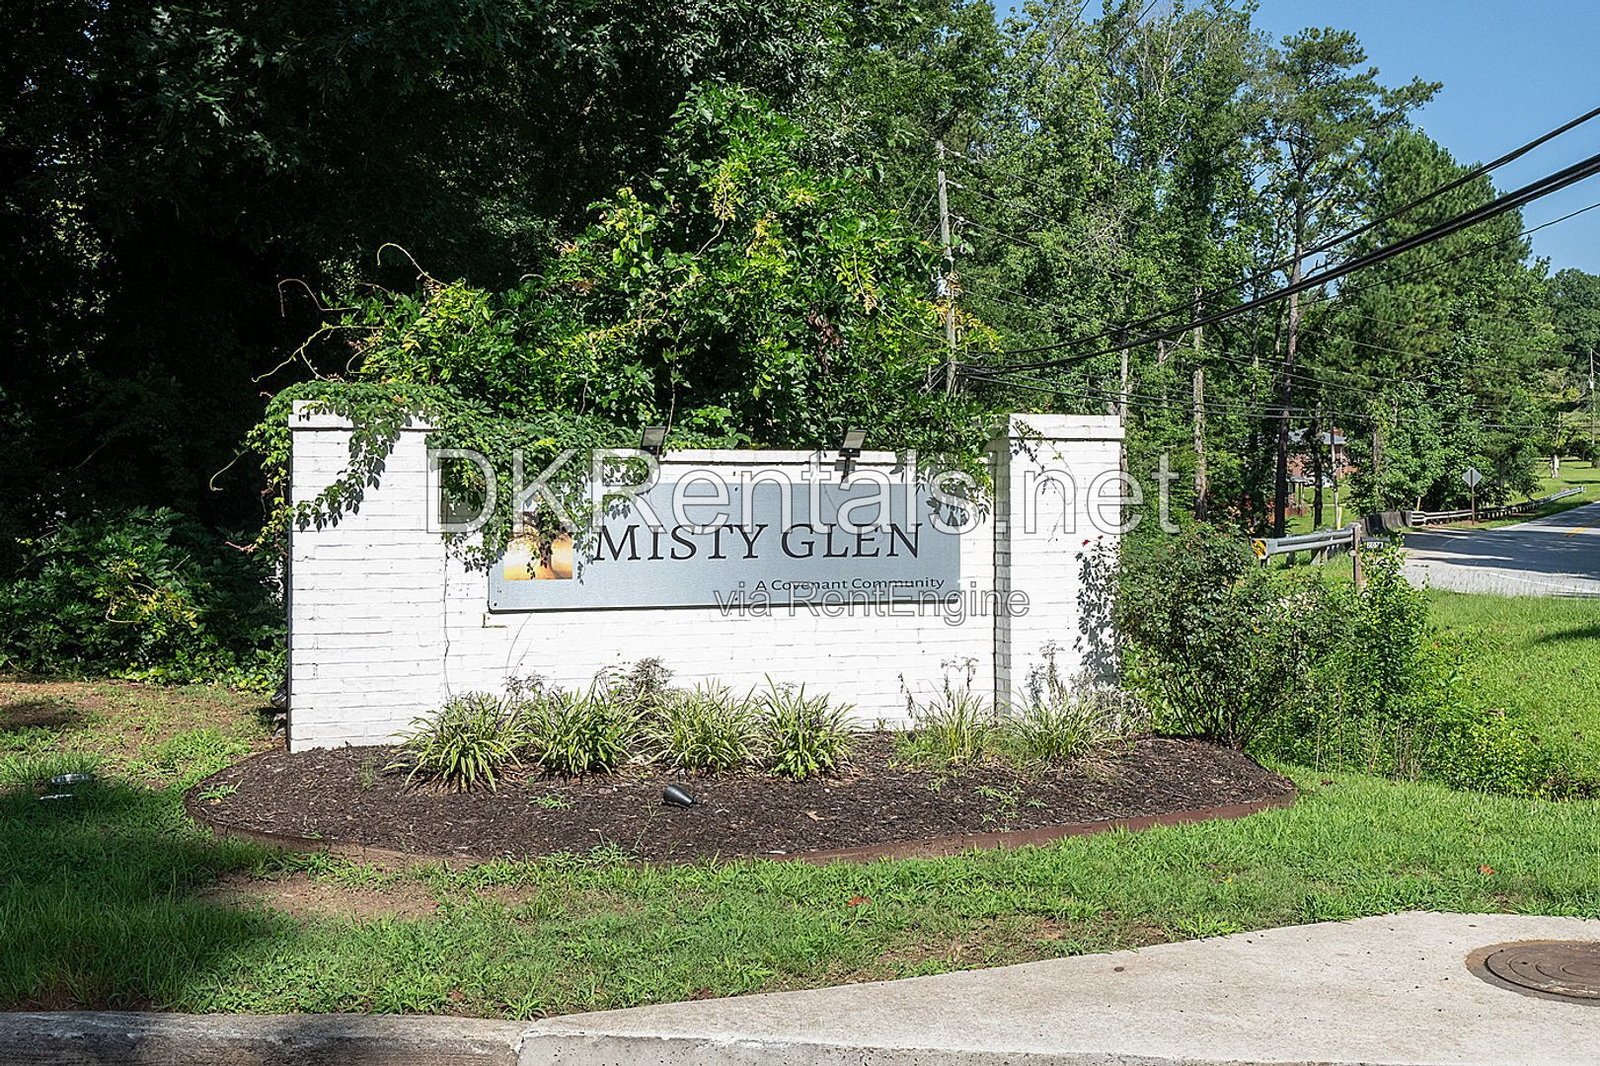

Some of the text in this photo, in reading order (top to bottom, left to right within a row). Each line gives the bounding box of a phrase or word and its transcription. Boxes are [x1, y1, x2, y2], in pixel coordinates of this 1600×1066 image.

[593, 522, 923, 561] MISTY GLEN
[755, 577, 945, 591] A Covenant Community
